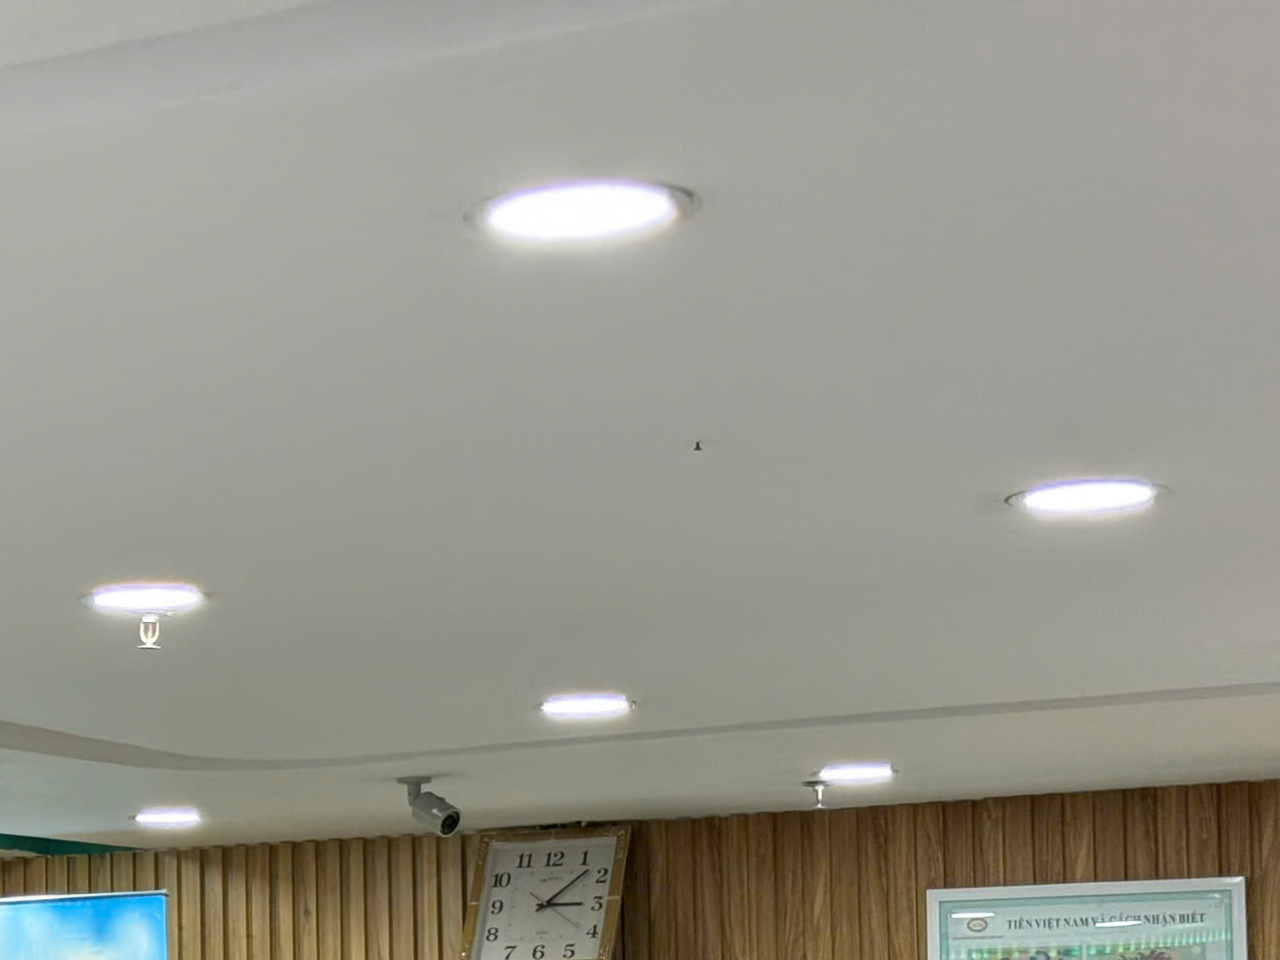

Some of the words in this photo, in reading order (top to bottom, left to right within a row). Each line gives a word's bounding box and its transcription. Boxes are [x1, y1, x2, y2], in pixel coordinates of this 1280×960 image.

[516, 853, 533, 868] 11
[544, 851, 565, 867] 12
[580, 850, 589, 866] 1
[491, 872, 511, 888] 10
[595, 868, 608, 884] 2
[490, 900, 504, 915] 9
[590, 896, 603, 912] 3
[586, 924, 598, 939] 4
[1034, 917, 1061, 931] VIỆT
[1063, 917, 1089, 928] NAM
[485, 927, 499, 942] 8
[504, 945, 517, 960] 7
[532, 944, 545, 960] 6
[562, 943, 576, 959] 5
